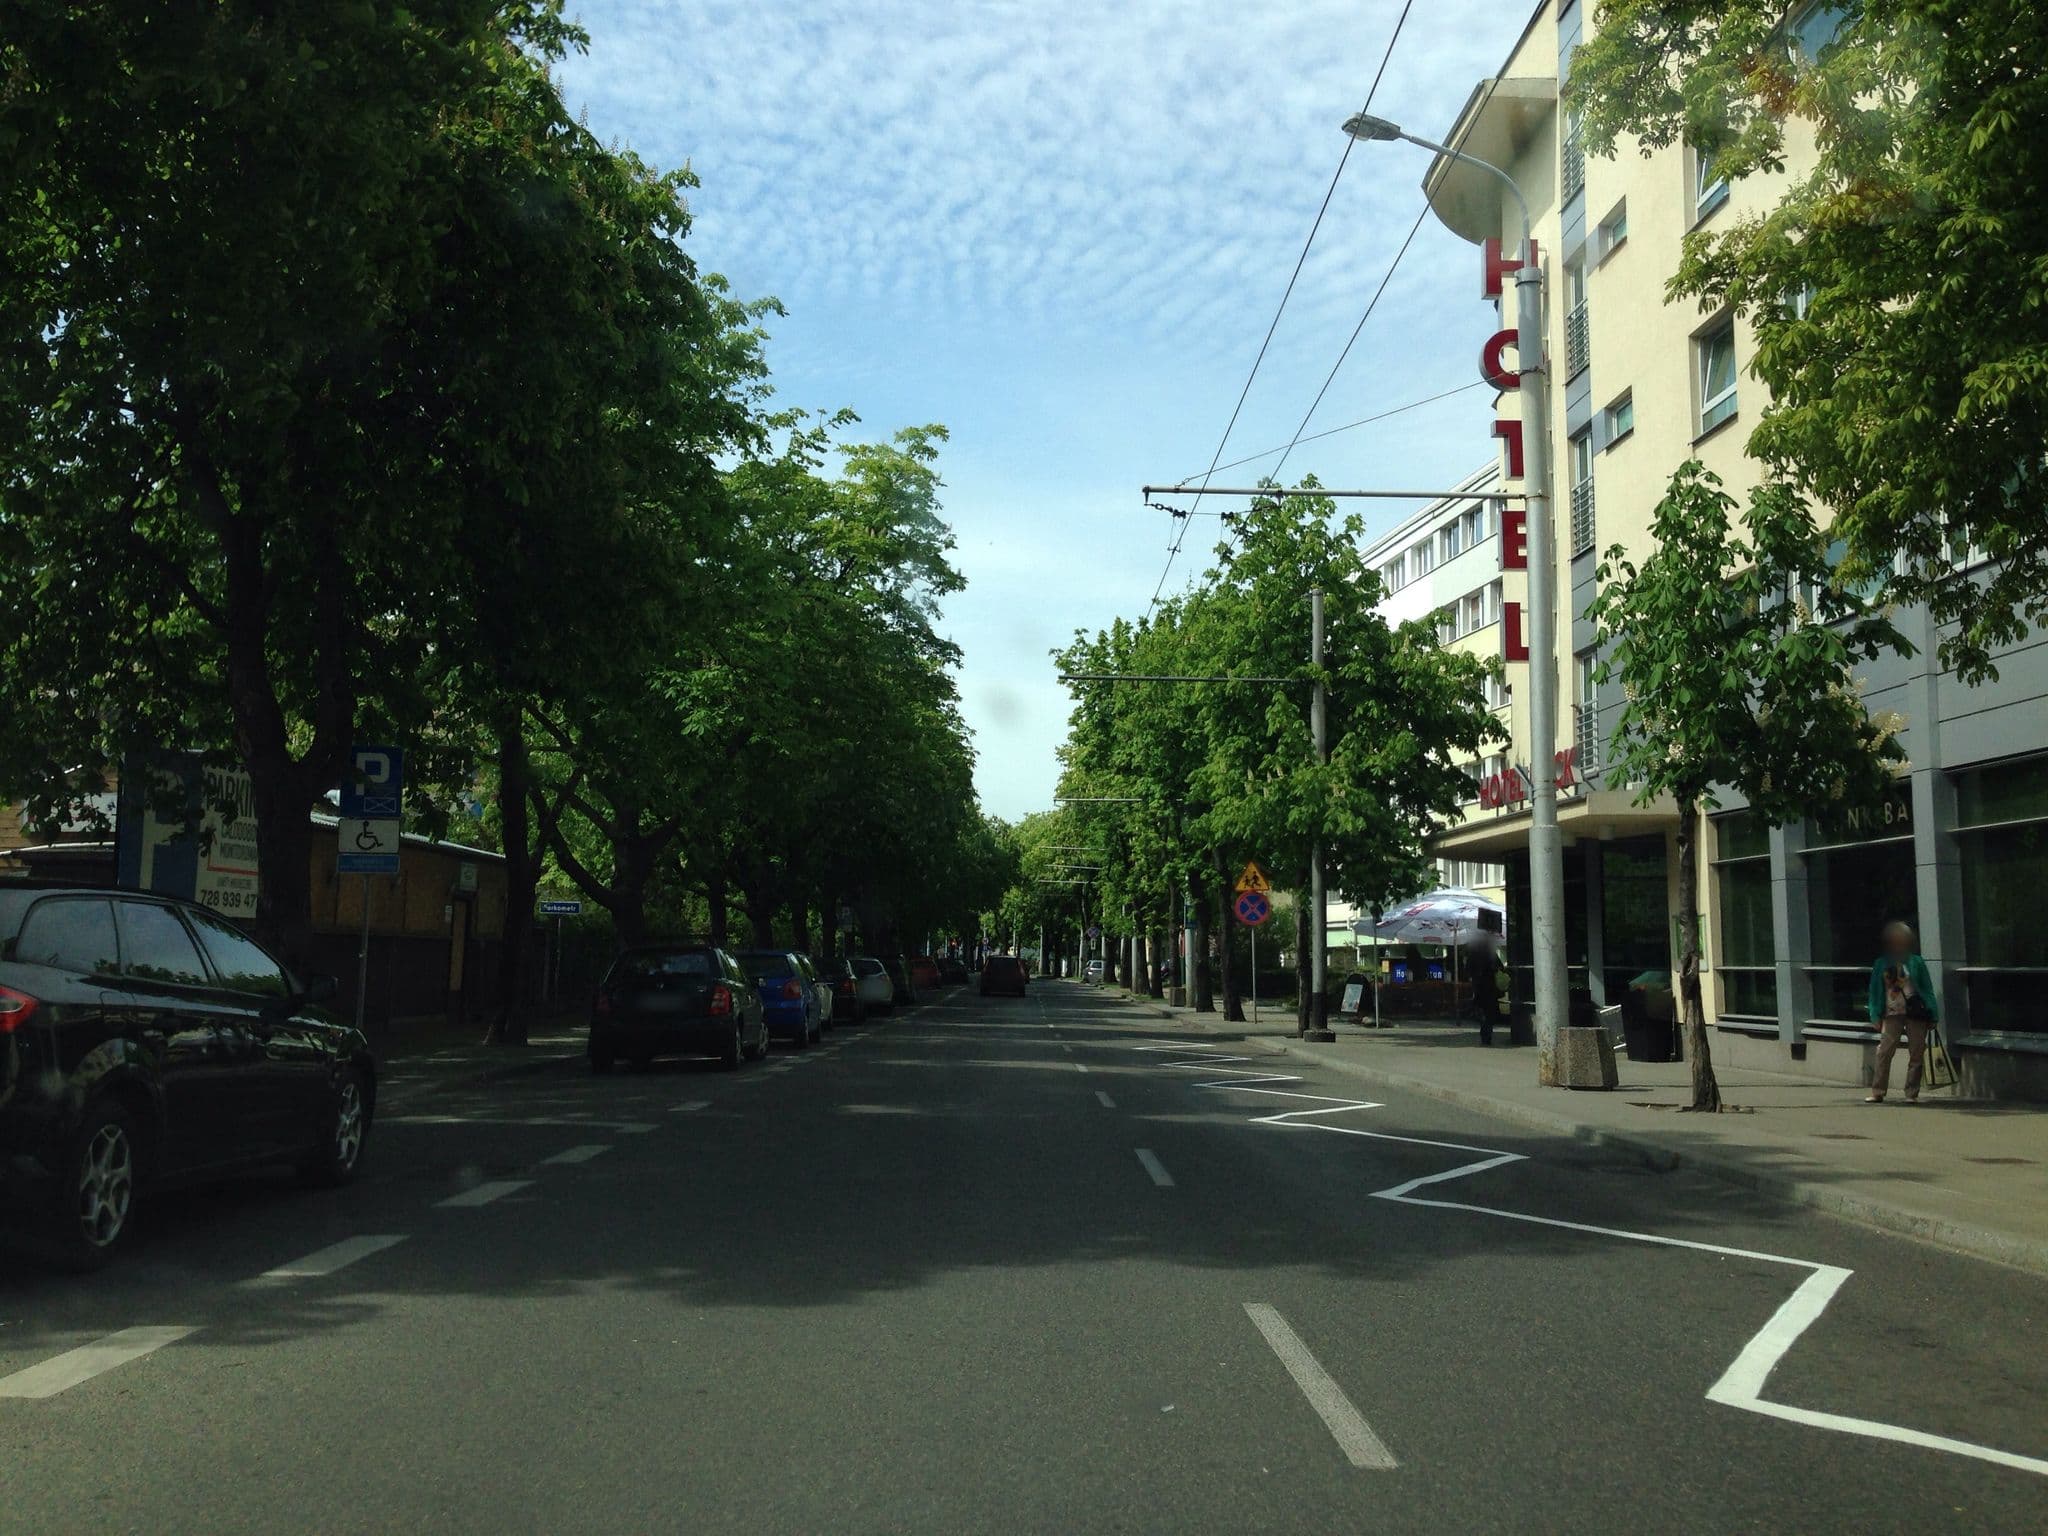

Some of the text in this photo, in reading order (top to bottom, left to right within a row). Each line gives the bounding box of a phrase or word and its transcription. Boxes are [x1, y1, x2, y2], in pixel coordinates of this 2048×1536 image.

[1480, 238, 1539, 662] HOTEL
[355, 751, 391, 796] P
[1480, 767, 1525, 810] HOTEL
[201, 889, 219, 906] 728
[223, 891, 241, 908] 939
